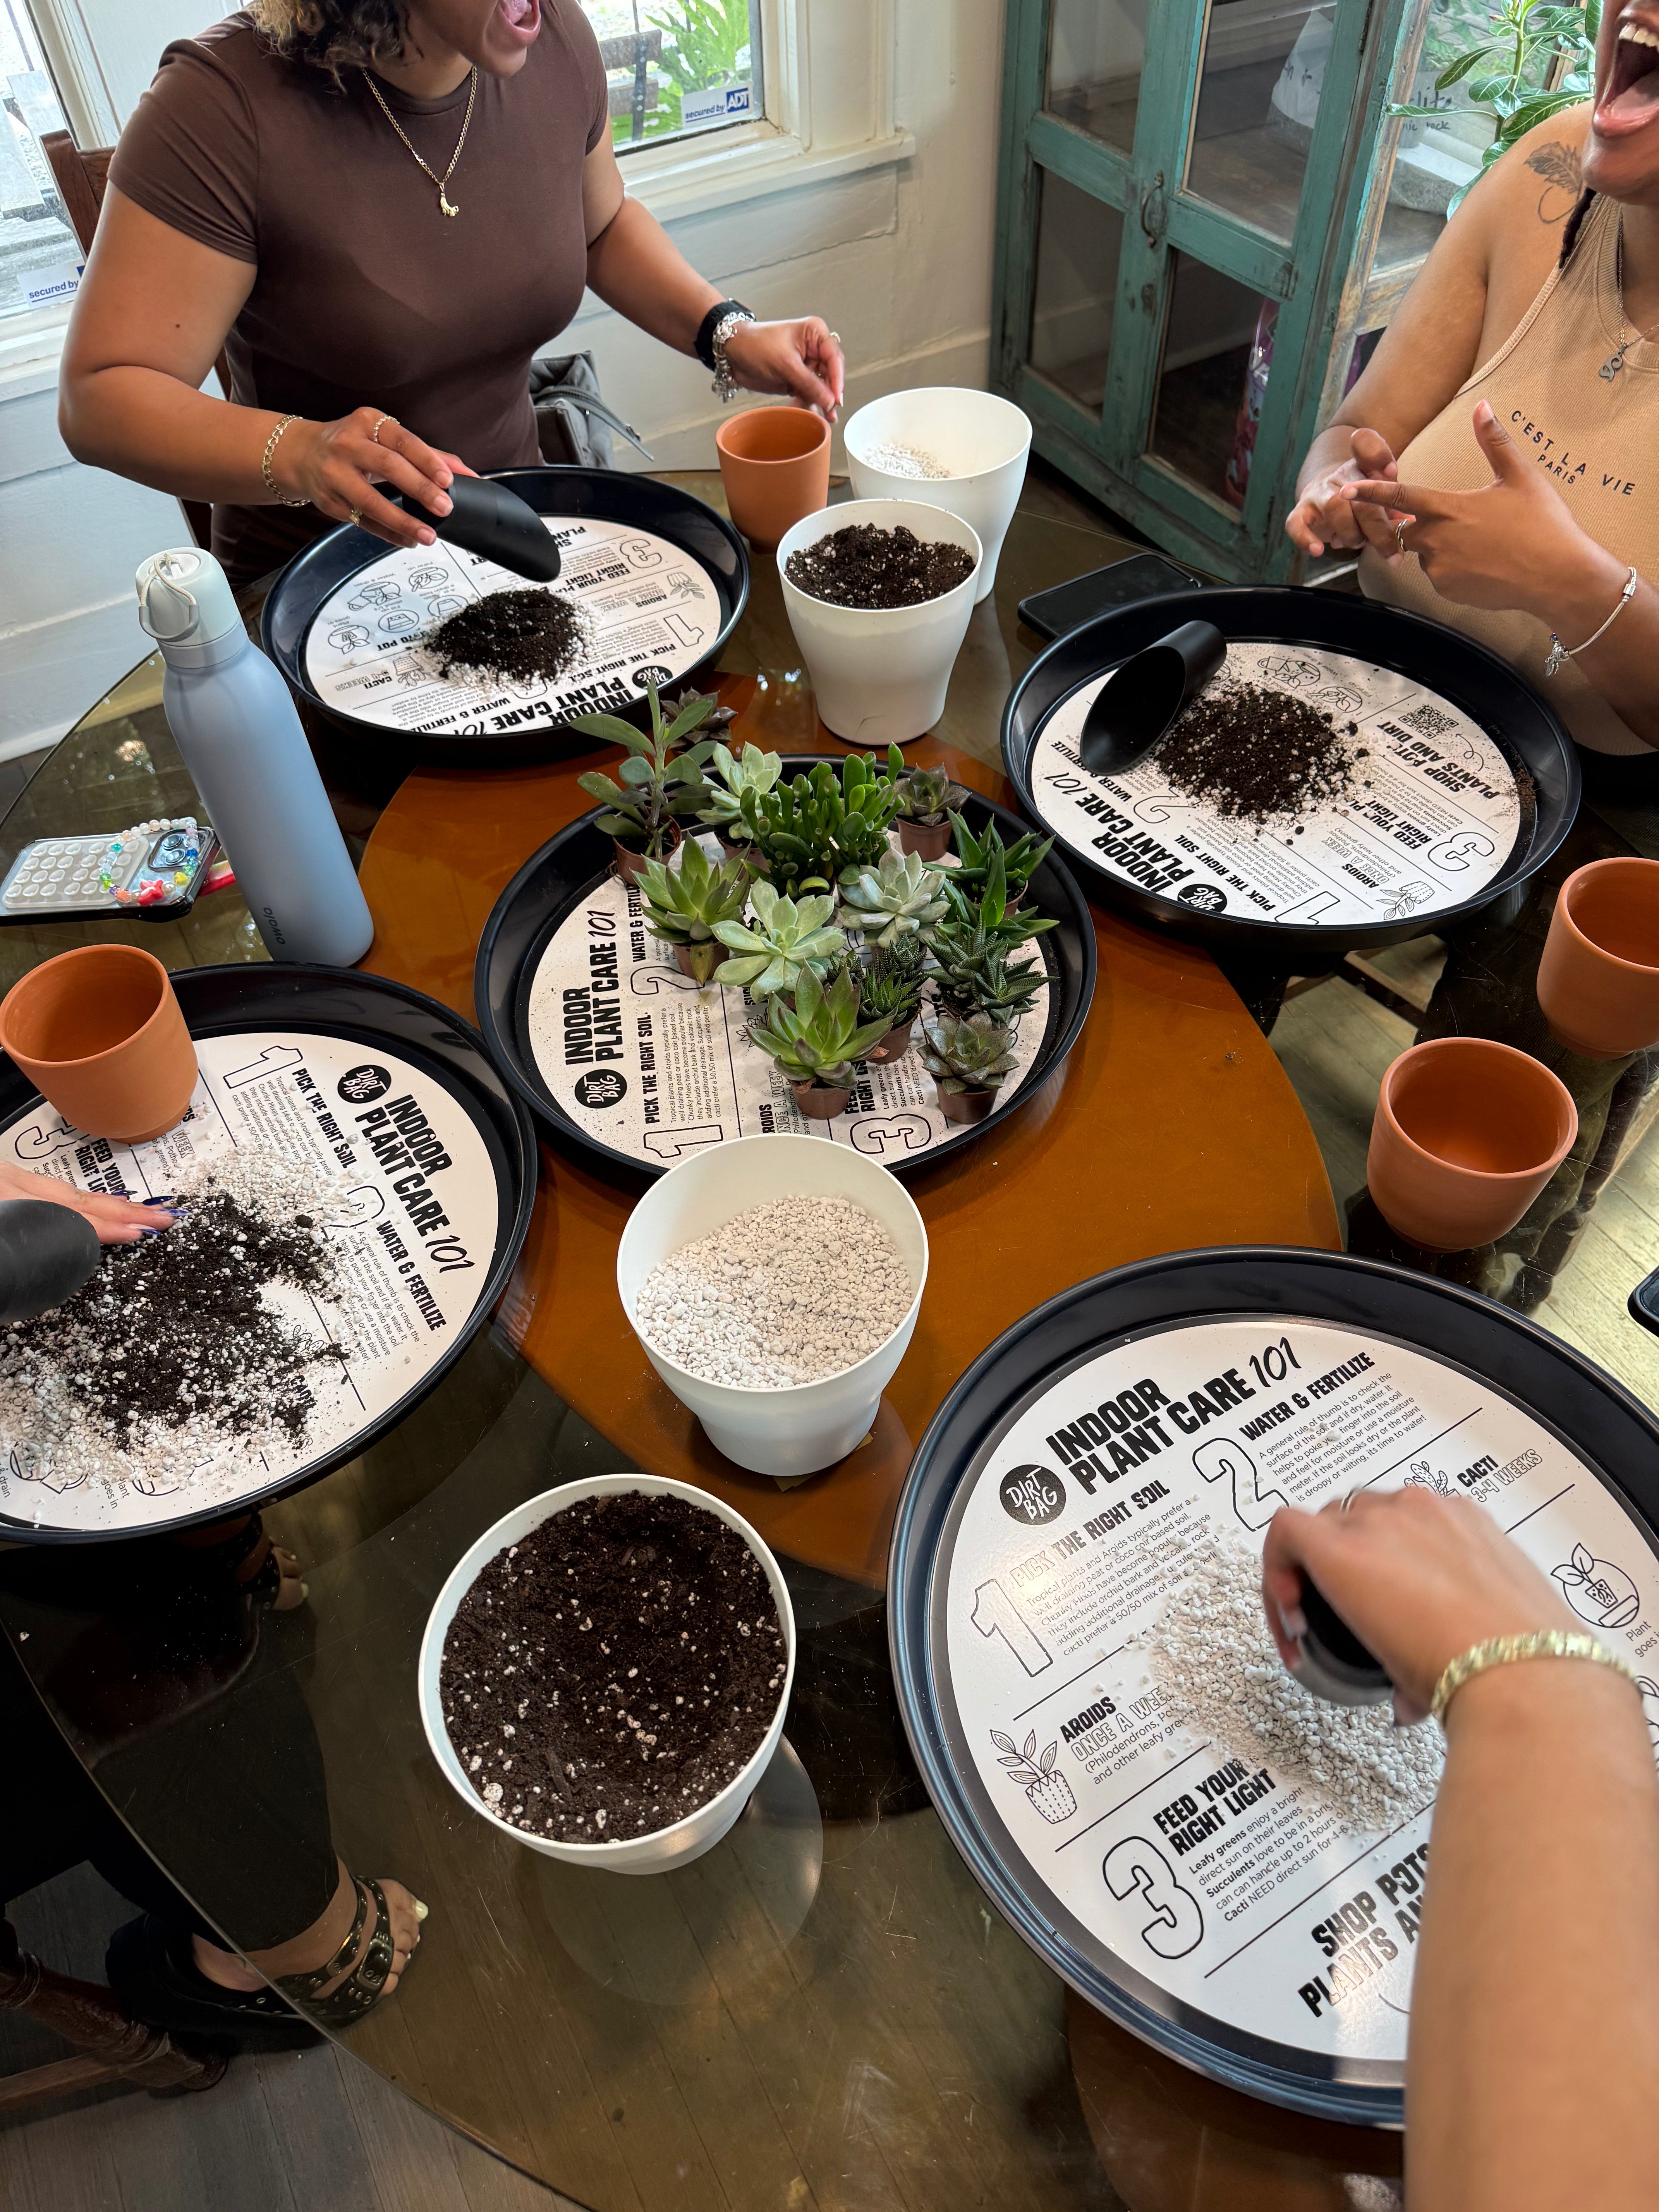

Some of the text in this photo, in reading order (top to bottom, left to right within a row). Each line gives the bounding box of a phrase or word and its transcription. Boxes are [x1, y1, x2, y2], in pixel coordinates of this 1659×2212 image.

[686, 105, 715, 118] secured
[727, 91, 750, 109] ADT
[29, 282, 66, 299] secured
[1511, 410, 1635, 496] C'EST LA VIE
[1537, 454, 1576, 484] PARIS
[618, 539, 662, 569] 3
[565, 563, 626, 585] RIGHT LIGHT
[577, 568, 630, 588] FEED YOUR
[635, 594, 667, 607] AROIDS
[377, 640, 398, 651] POT
[663, 613, 705, 648] 1
[596, 644, 677, 674] PICK THE RIGHT
[335, 676, 371, 691] WEEKS
[364, 676, 392, 689] CACTI
[472, 698, 511, 714] WATER
[490, 677, 626, 730] PLANT CARE
[1376, 721, 1503, 799] PLANTS AND DIRT
[1098, 775, 1132, 802] WATER
[1424, 768, 1466, 792] SHOP
[1044, 772, 1195, 882] PLANT CARE 101
[1365, 800, 1432, 843] RIGHT LIGHT
[1393, 831, 1422, 849] FEED
[1091, 832, 1168, 892] INDOOR
[1321, 837, 1389, 884] ONCE A WEEK
[1428, 831, 1495, 872] 3
[1175, 835, 1276, 911] PICK THE RIGHT SOIL
[1341, 864, 1379, 888] AROIDS
[1194, 887, 1223, 905] BAG
[1274, 891, 1341, 925] 1
[263, 907, 285, 945] owala
[587, 908, 616, 937] 101
[630, 931, 646, 962] WATER
[590, 942, 623, 1061] PLANT CARE
[563, 987, 594, 1065] INDOOR
[662, 1030, 670, 1051] typically
[223, 1046, 304, 1089] 1
[639, 1042, 655, 1071] RIGHT
[343, 1078, 369, 1099] BAG
[356, 1068, 387, 1091] DIRT
[584, 1075, 605, 1103] DIRT
[601, 1075, 621, 1097] BAG
[642, 1075, 657, 1094] THE
[769, 1068, 788, 1108] A WEEK
[854, 1077, 876, 1112] RIGHT
[292, 1068, 357, 1168] PICK THE RIGHT SOIL
[644, 1097, 660, 1124] PICK
[91, 1137, 113, 1163] FEED
[172, 1129, 195, 1158] WEEK
[384, 1094, 452, 1177] INDOOR
[643, 1123, 723, 1159] 1
[850, 1113, 932, 1154] 3
[74, 1145, 100, 1177] RIGHT
[355, 1107, 475, 1273] PLANT CARE 101
[376, 1220, 447, 1331] WATER & FERTILIZE
[372, 1259, 381, 1269] rule
[383, 1278, 398, 1297] thumb
[401, 1312, 414, 1331] check
[411, 1331, 419, 1342] the
[1239, 1352, 1375, 1441] WATER & FERTILIZE
[1267, 1434, 1294, 1455] general
[1294, 1426, 1309, 1437] rule
[1309, 1418, 1317, 1426] of
[1317, 1405, 1341, 1421] thumb
[1358, 1381, 1379, 1396] check
[1378, 1374, 1391, 1382] the
[1046, 1379, 1171, 1465] INDOOR
[1068, 1337, 1302, 1495] PLANT CARE 101
[1282, 1472, 1297, 1484] and
[1296, 1462, 1312, 1475] feel
[1310, 1456, 1322, 1465] for
[1323, 1436, 1355, 1458] moisture
[1364, 1421, 1377, 1431] use
[1383, 1398, 1414, 1419] moisture
[1006, 1467, 1043, 1508] DIRT
[1192, 1437, 1290, 1532] 2
[1457, 1455, 1499, 1487] CACTI
[1471, 1449, 1542, 1502] 3-4 WEEKS
[1025, 1488, 1058, 1520] BAG
[1008, 1480, 1170, 1589] PICK THE RIGHT SOIL
[970, 1578, 1053, 1677] 1
[1626, 1621, 1652, 1642] Plant
[1635, 1637, 1657, 1657] goes
[1060, 1697, 1116, 1743] AROIDS
[1071, 1713, 1134, 1761] ONCE A
[1153, 1758, 1250, 1835] FEED YOUR
[1168, 1768, 1276, 1856] RIGHT LIGHT
[1189, 1853, 1215, 1874] Leafy
[1216, 1831, 1246, 1856] greens
[1247, 1812, 1270, 1832] enjoy
[1276, 1787, 1304, 1809] bright
[1102, 1836, 1204, 1960] 3
[1311, 1891, 1377, 1957] SHOP
[1298, 1927, 1398, 2018] PLANTS
